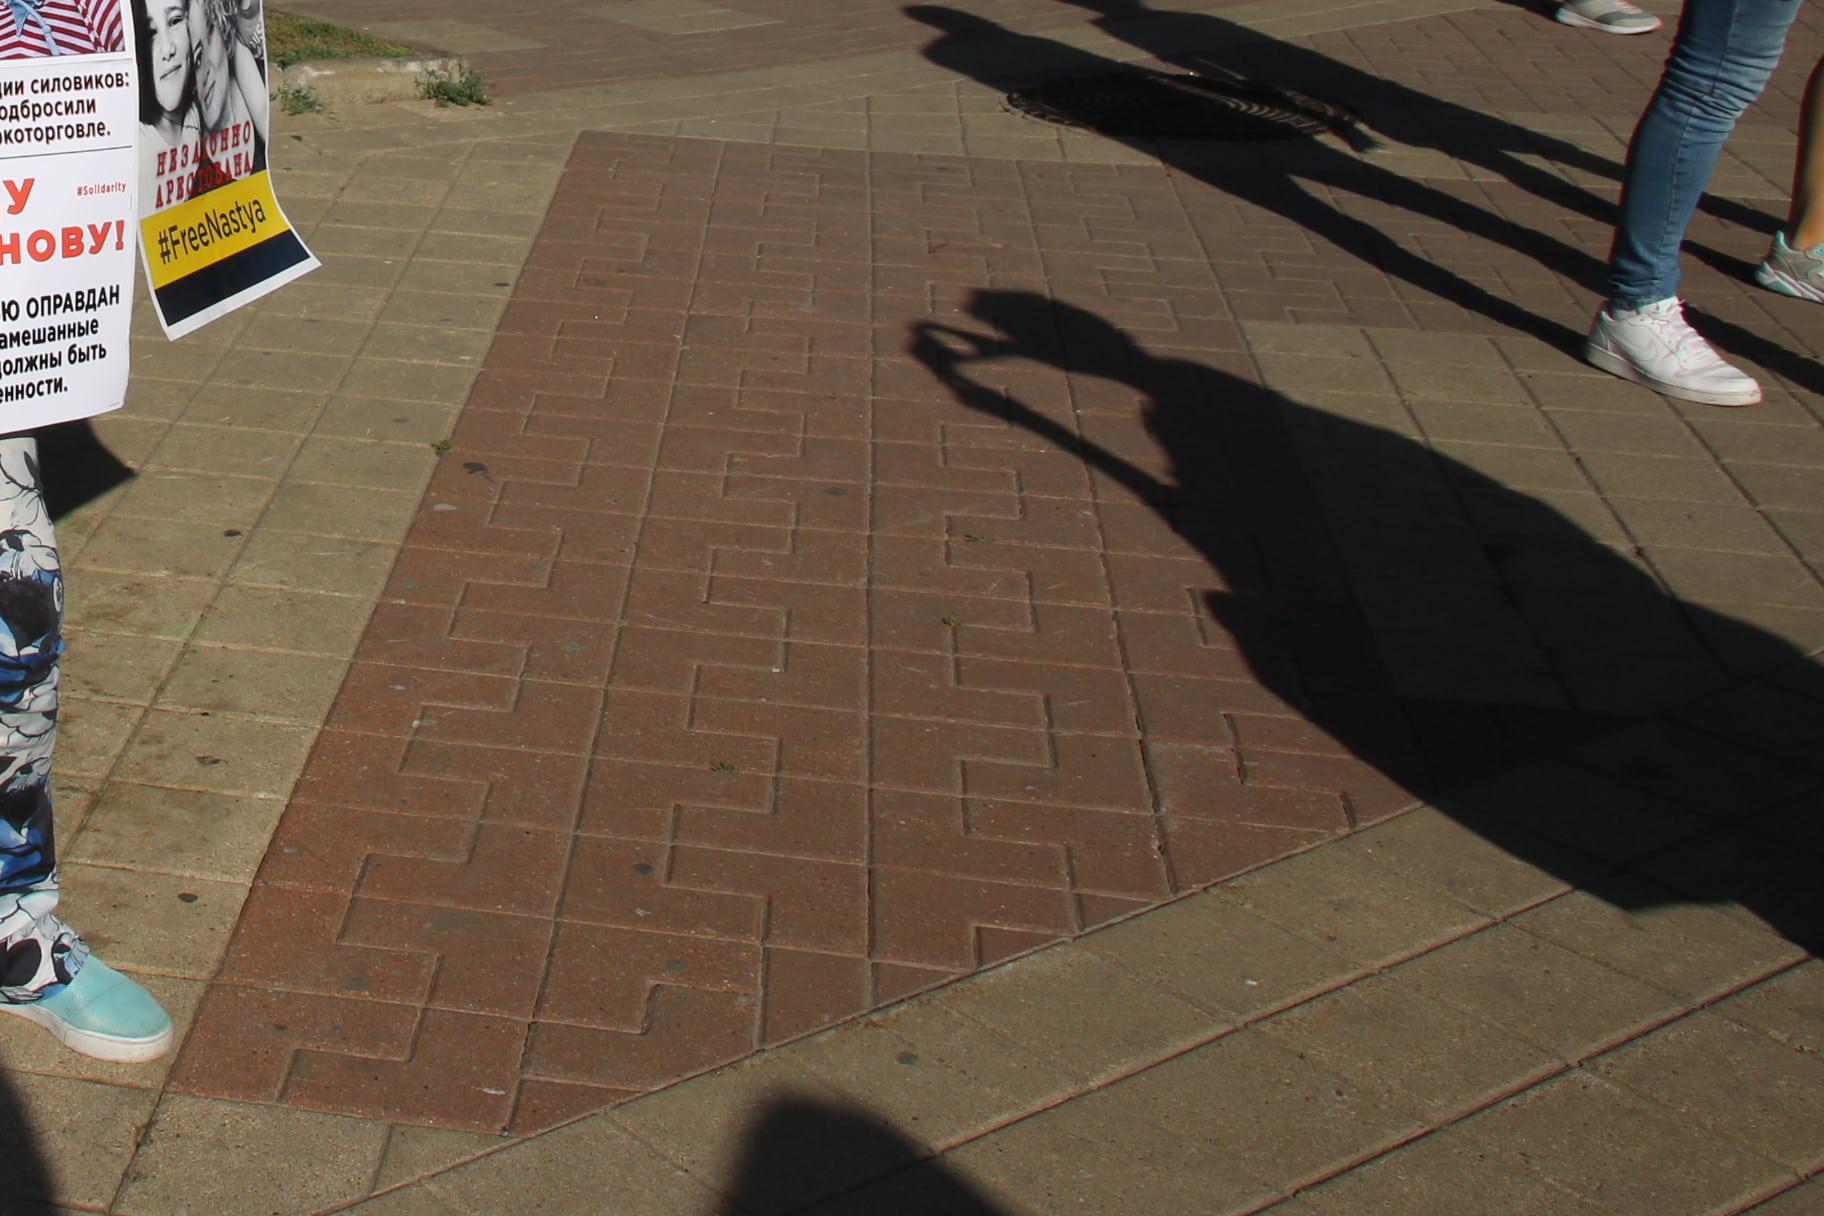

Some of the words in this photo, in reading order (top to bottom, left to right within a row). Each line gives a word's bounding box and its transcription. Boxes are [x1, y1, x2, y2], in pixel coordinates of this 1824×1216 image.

[31, 73, 129, 94] силовиков:
[156, 120, 251, 177] НЕЗАКОННО
[155, 152, 252, 209] АРЕСТОВАНА
[158, 199, 266, 265] #FreeNastya
[26, 285, 119, 318] ОПРАВДАН
[68, 344, 106, 364] быть
